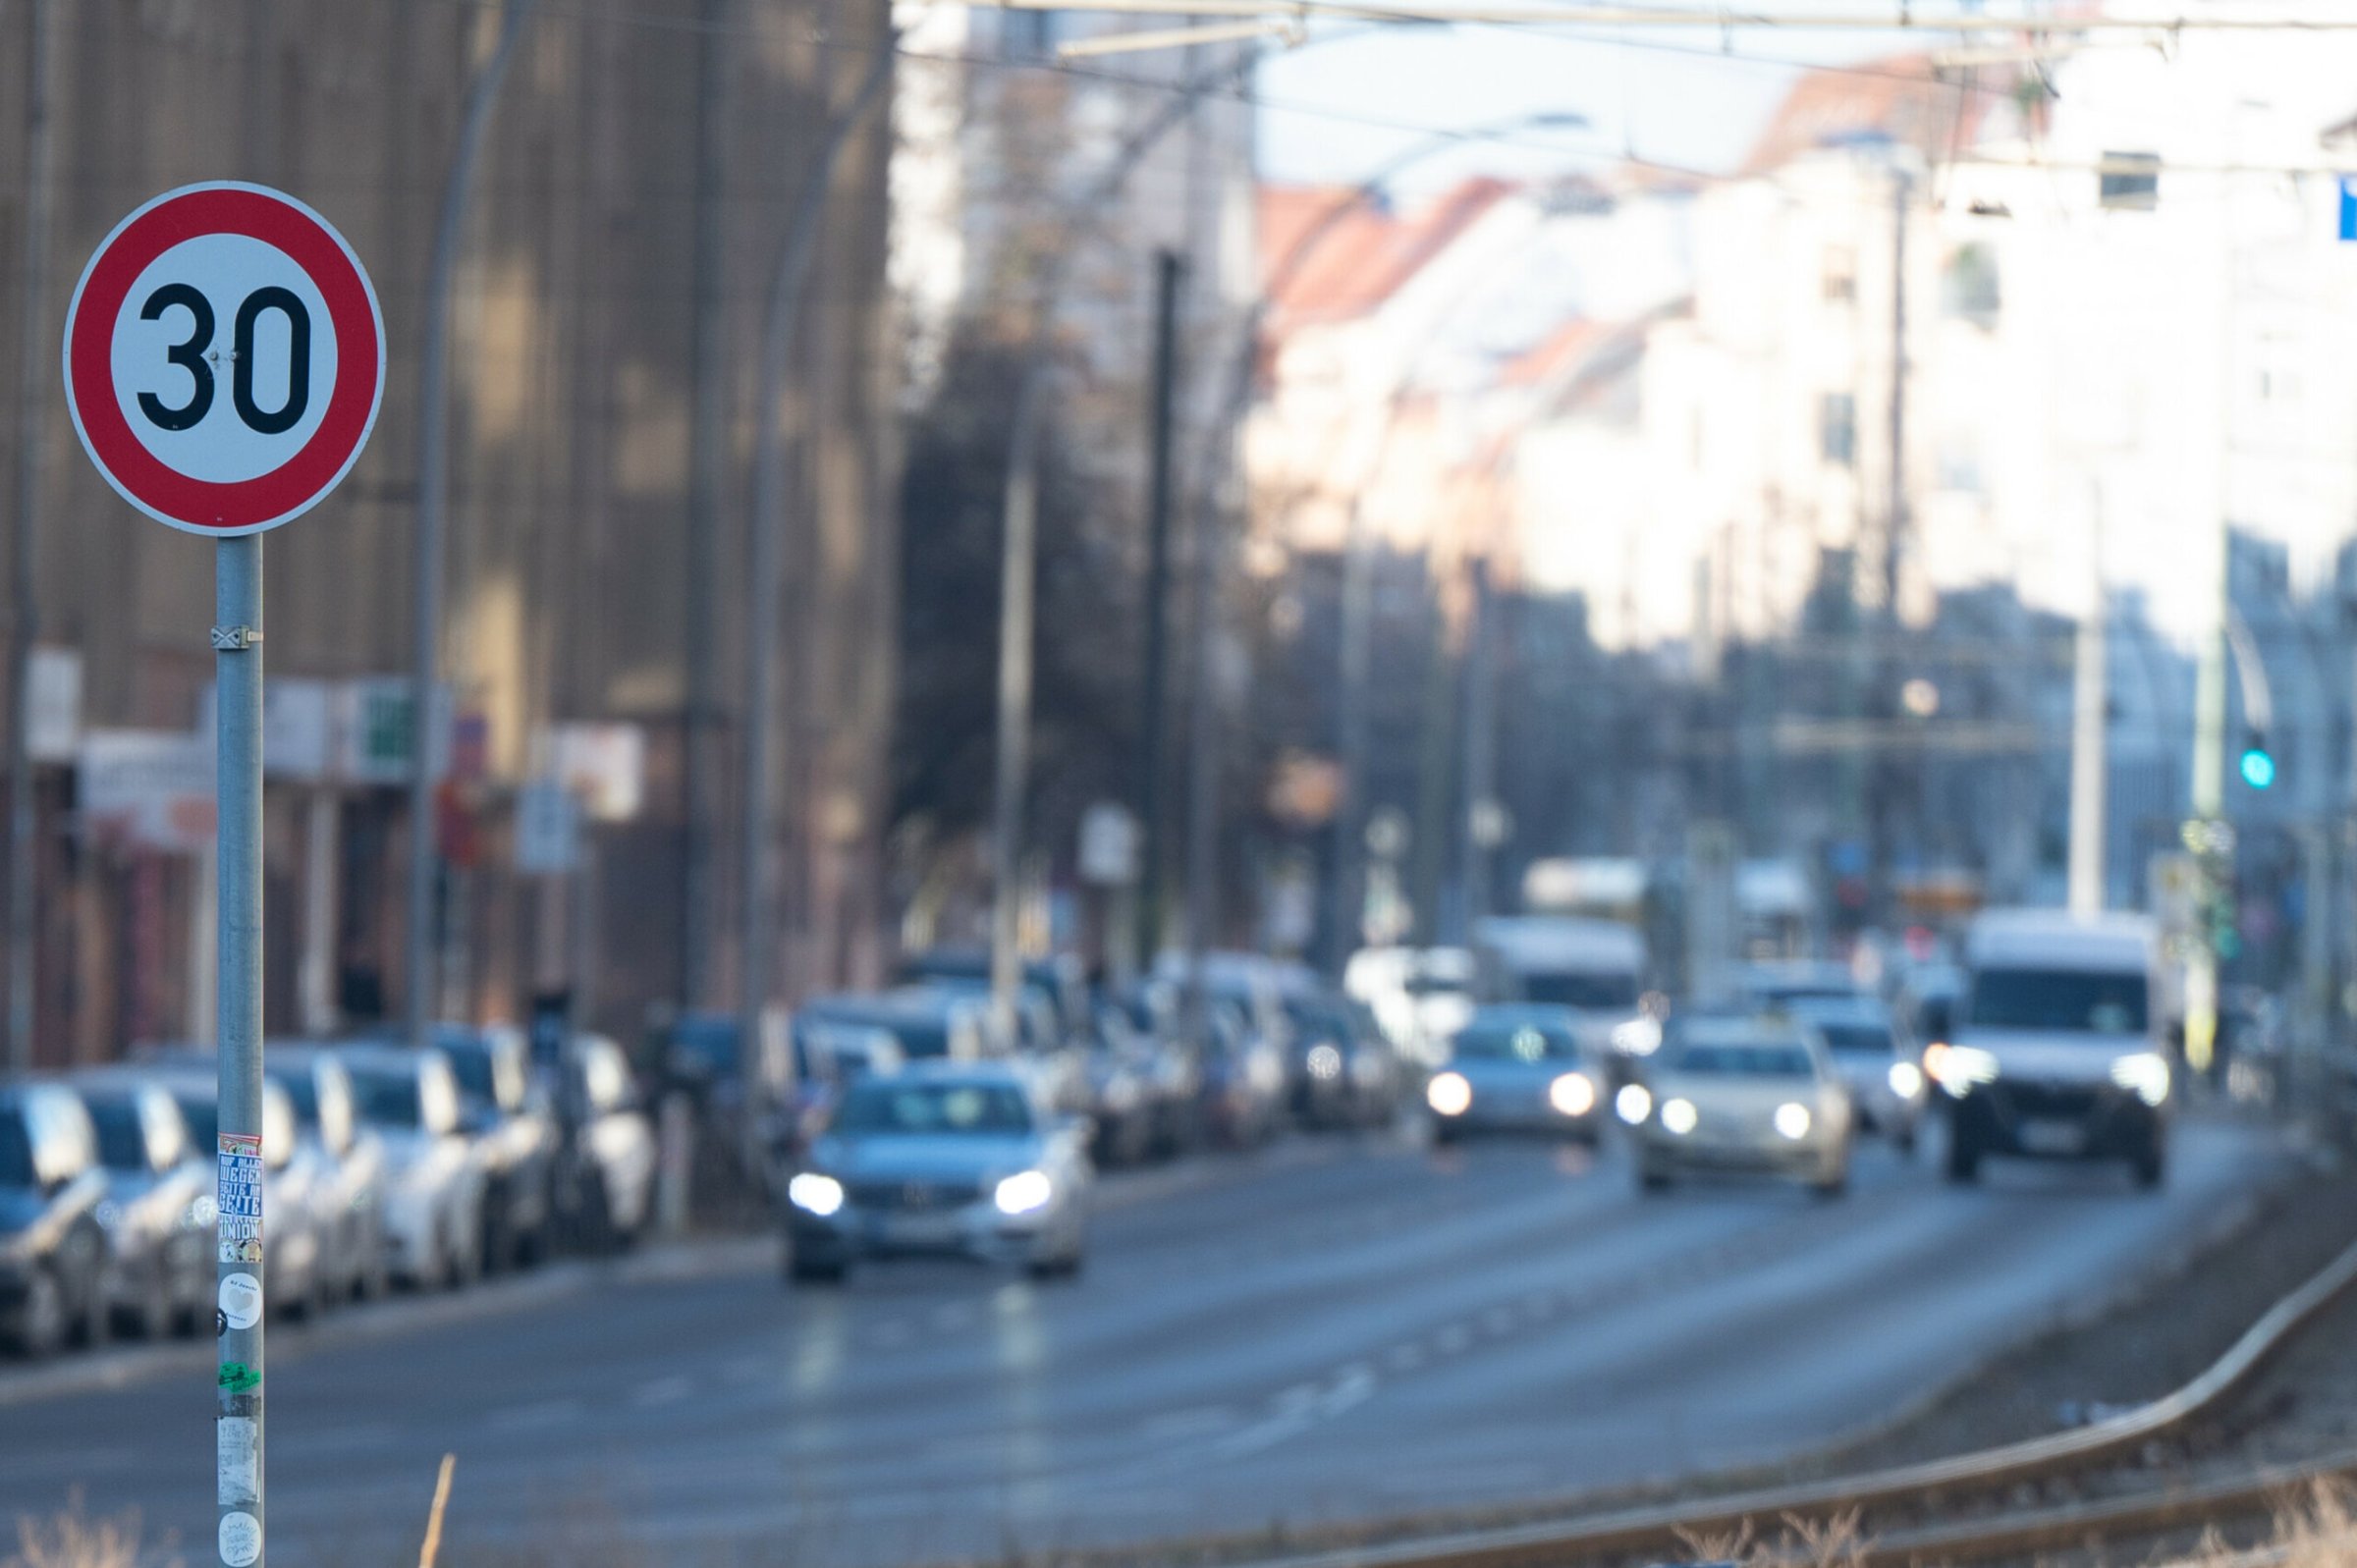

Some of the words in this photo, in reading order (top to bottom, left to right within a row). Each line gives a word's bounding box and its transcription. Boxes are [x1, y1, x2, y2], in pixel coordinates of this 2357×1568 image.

[137, 283, 311, 435] 30
[220, 1165, 261, 1184] WEGEN
[220, 1181, 247, 1196] SEITE
[219, 1194, 260, 1215] SEITE
[220, 1222, 258, 1240] UNION
